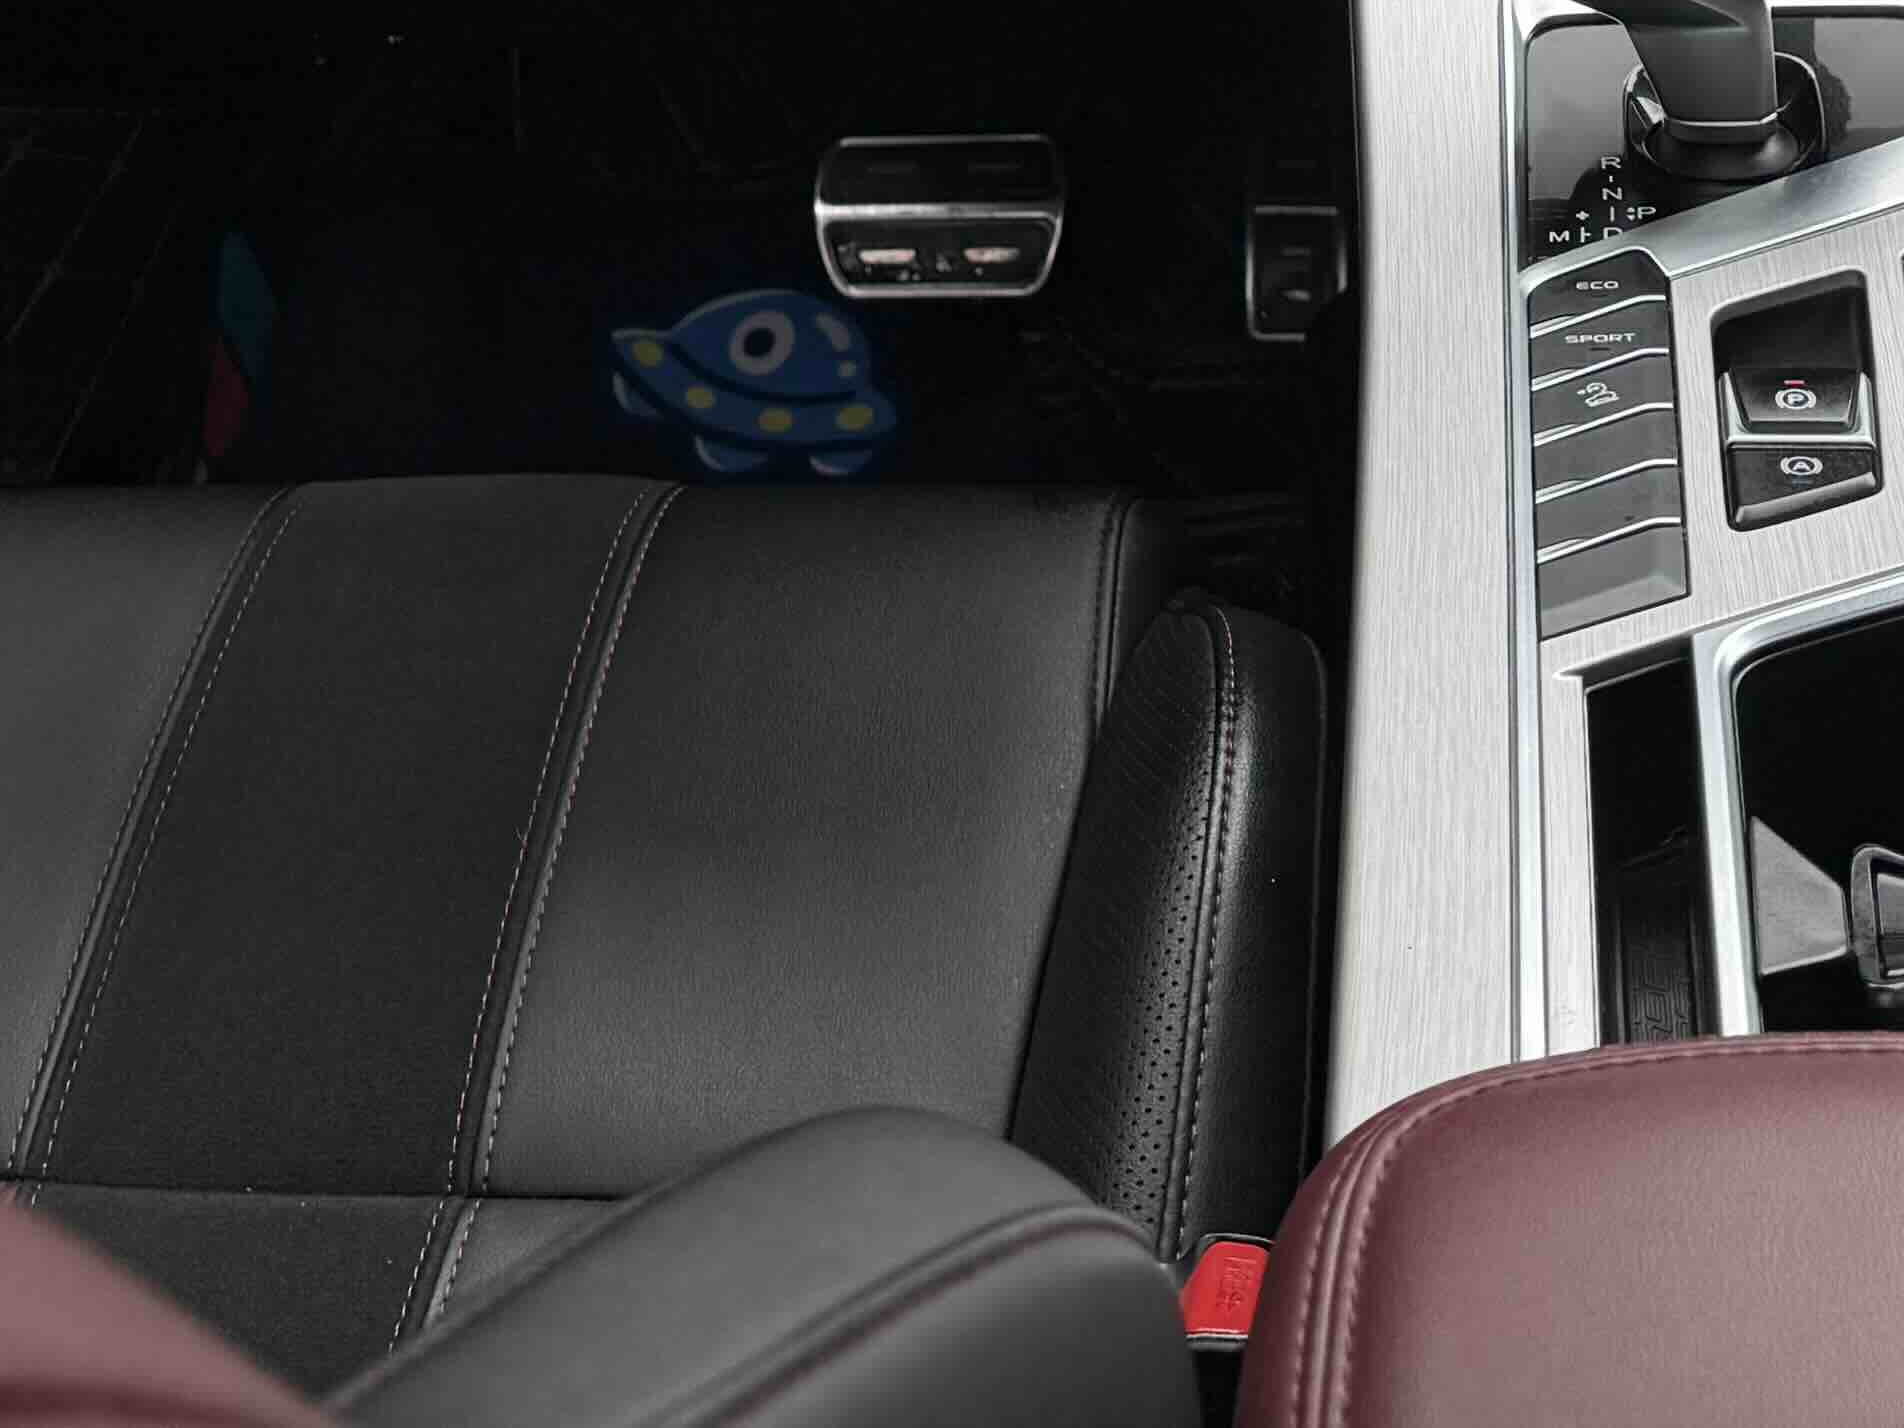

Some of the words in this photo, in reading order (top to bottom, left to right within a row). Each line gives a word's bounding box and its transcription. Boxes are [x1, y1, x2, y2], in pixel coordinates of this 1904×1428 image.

[1600, 156, 1622, 170] R
[1601, 186, 1623, 201] N
[1637, 206, 1656, 220] P
[1549, 230, 1570, 243] M
[1576, 280, 1619, 290] ECO
[1565, 332, 1636, 344] SPORT
